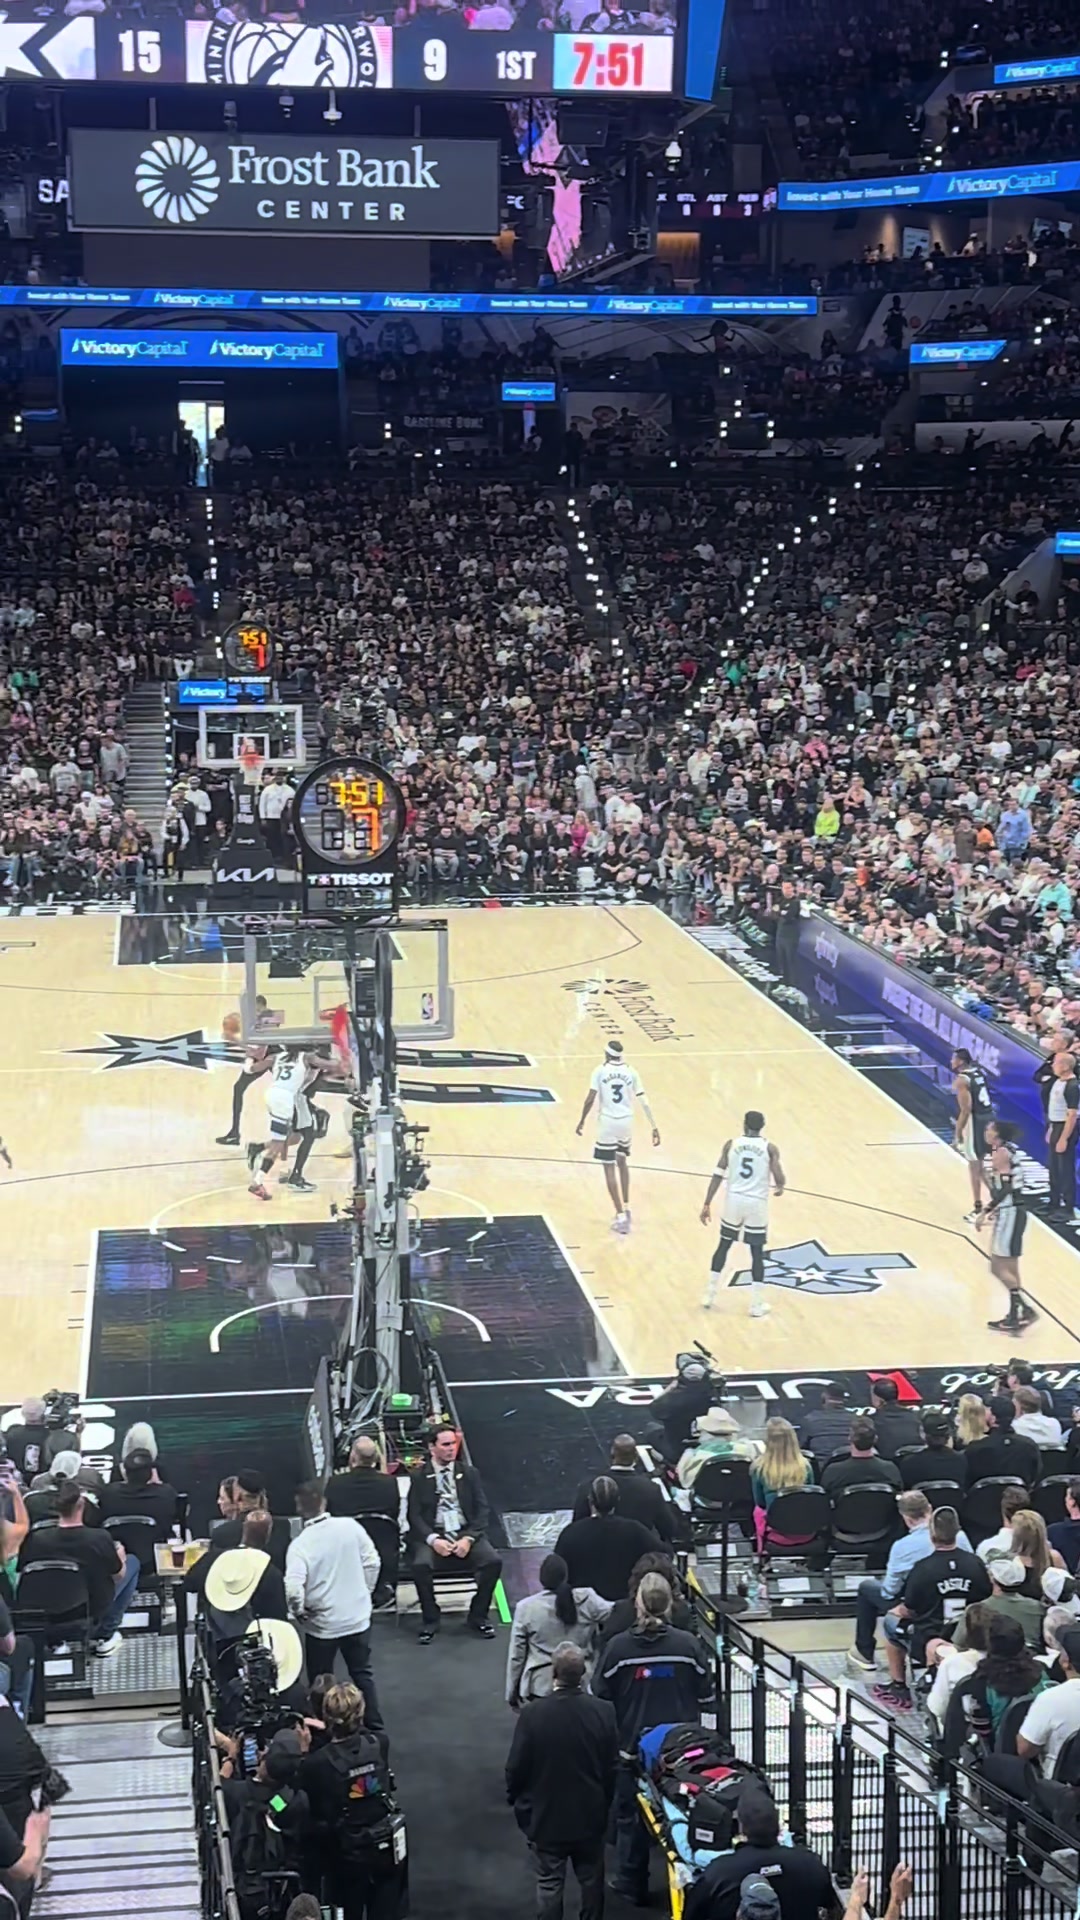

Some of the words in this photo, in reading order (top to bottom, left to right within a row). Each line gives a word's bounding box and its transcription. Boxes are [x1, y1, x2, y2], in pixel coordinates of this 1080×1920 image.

[118, 29, 161, 73] 15
[423, 38, 447, 81] 9
[496, 50, 537, 80] 1ST
[573, 41, 644, 87] 7:51
[228, 145, 329, 186] Frost
[337, 144, 440, 189] Bank
[257, 199, 405, 221] CENTER
[81, 340, 189, 358] VictoryCapital
[219, 341, 325, 360] VictoryCapital
[331, 873, 394, 886] TISSOT
[275, 1065, 292, 1081] 13
[611, 1084, 624, 1104] 3
[739, 1157, 754, 1180] 5
[937, 1578, 972, 1594] CASTLE
